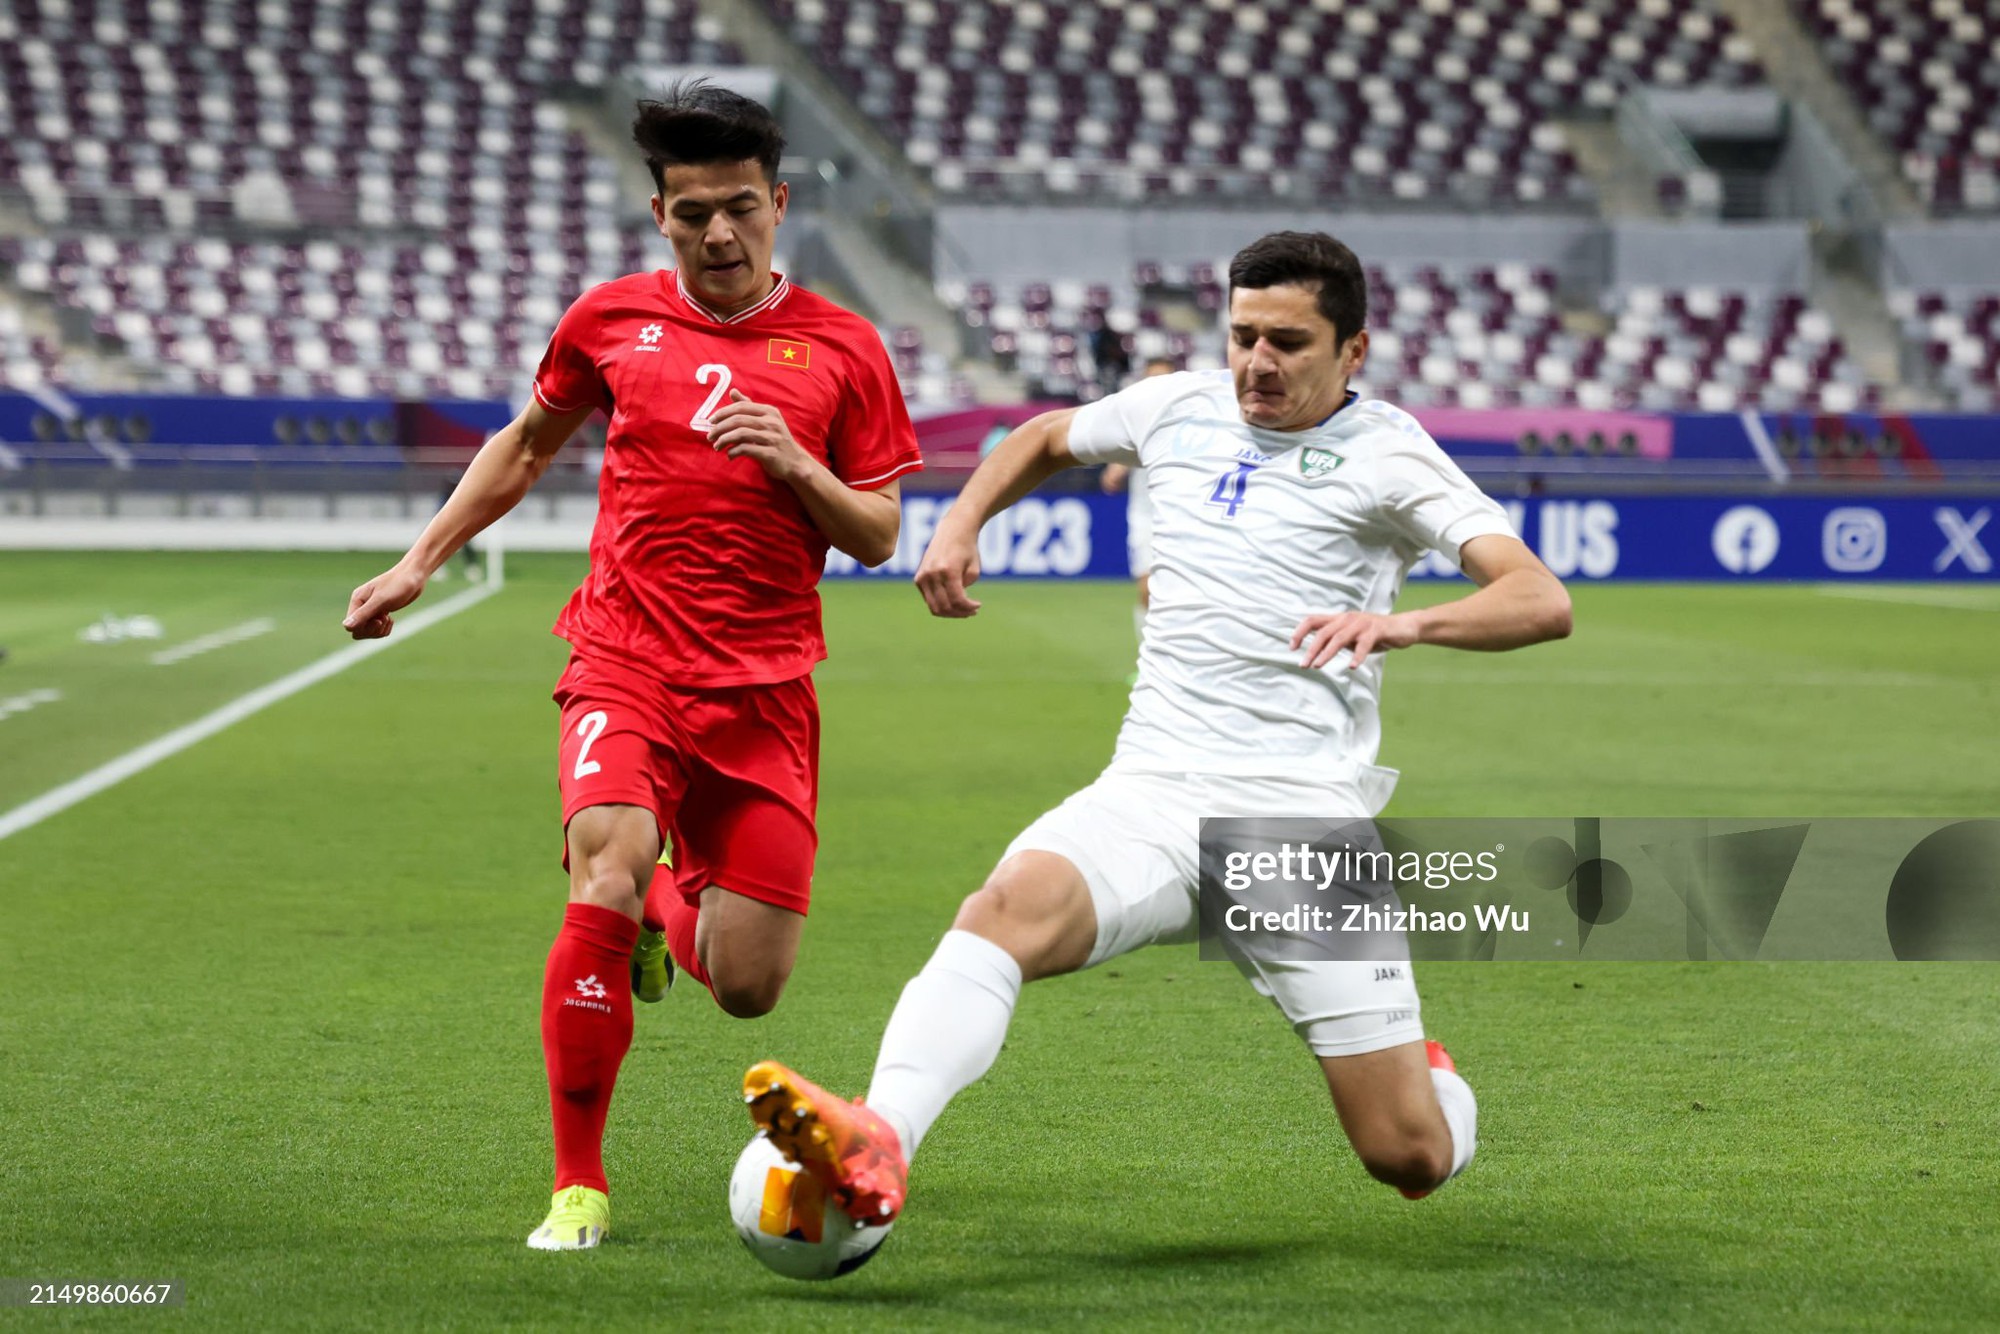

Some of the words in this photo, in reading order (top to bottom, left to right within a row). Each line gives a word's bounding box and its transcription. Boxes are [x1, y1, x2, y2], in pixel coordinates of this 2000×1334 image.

[691, 364, 731, 432] 2
[1204, 462, 1260, 520] 4
[1304, 449, 1338, 470] UFA
[1540, 500, 1620, 578] US
[573, 710, 608, 781] 2
